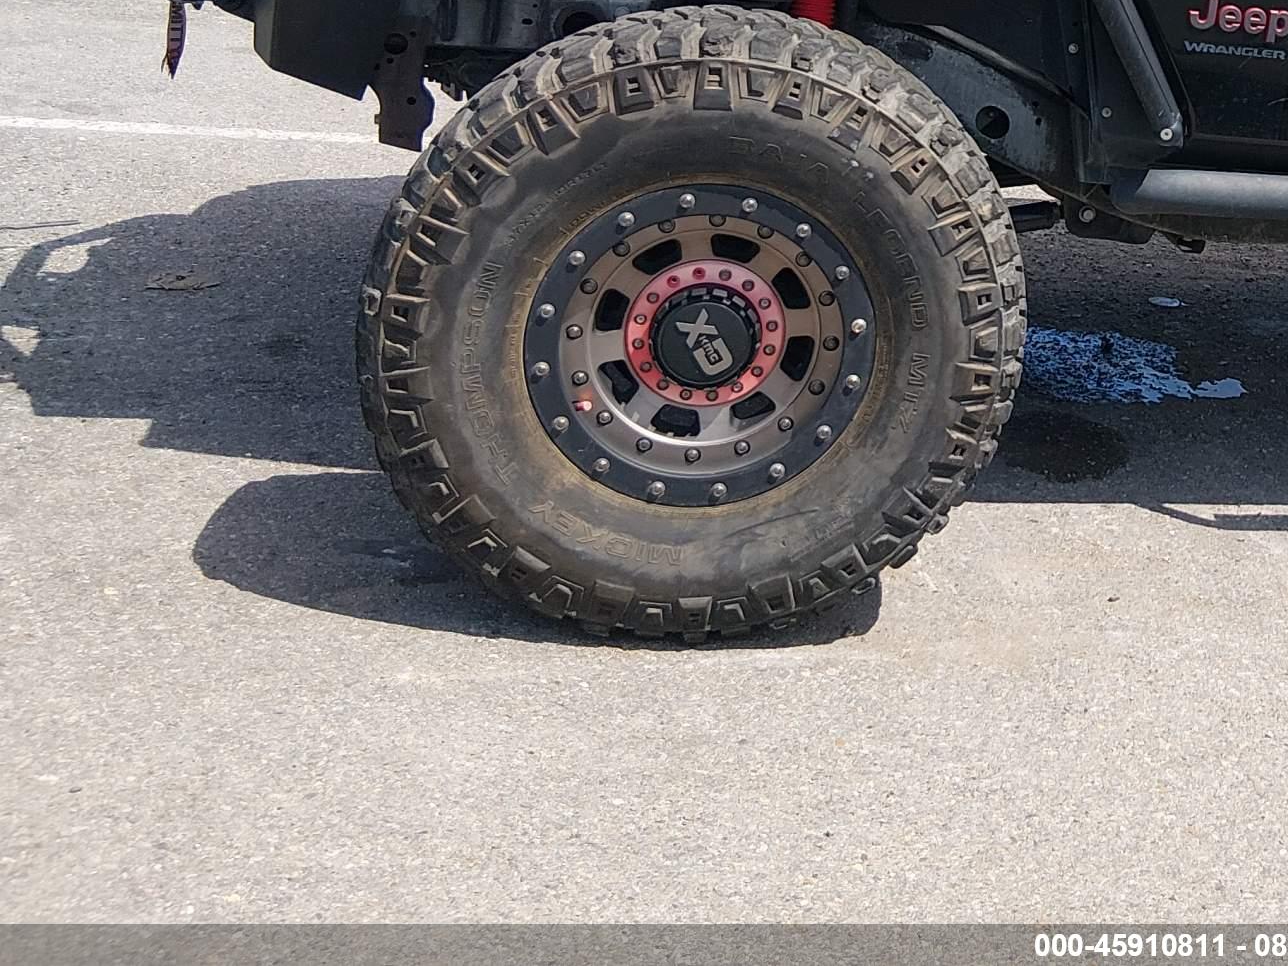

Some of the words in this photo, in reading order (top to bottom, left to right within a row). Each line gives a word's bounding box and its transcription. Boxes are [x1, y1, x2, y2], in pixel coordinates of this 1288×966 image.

[1183, 40, 1287, 60] WRANGLER
[460, 260, 520, 487] THOMPSON
[675, 307, 734, 376] XD
[527, 500, 686, 567] MICKEY
